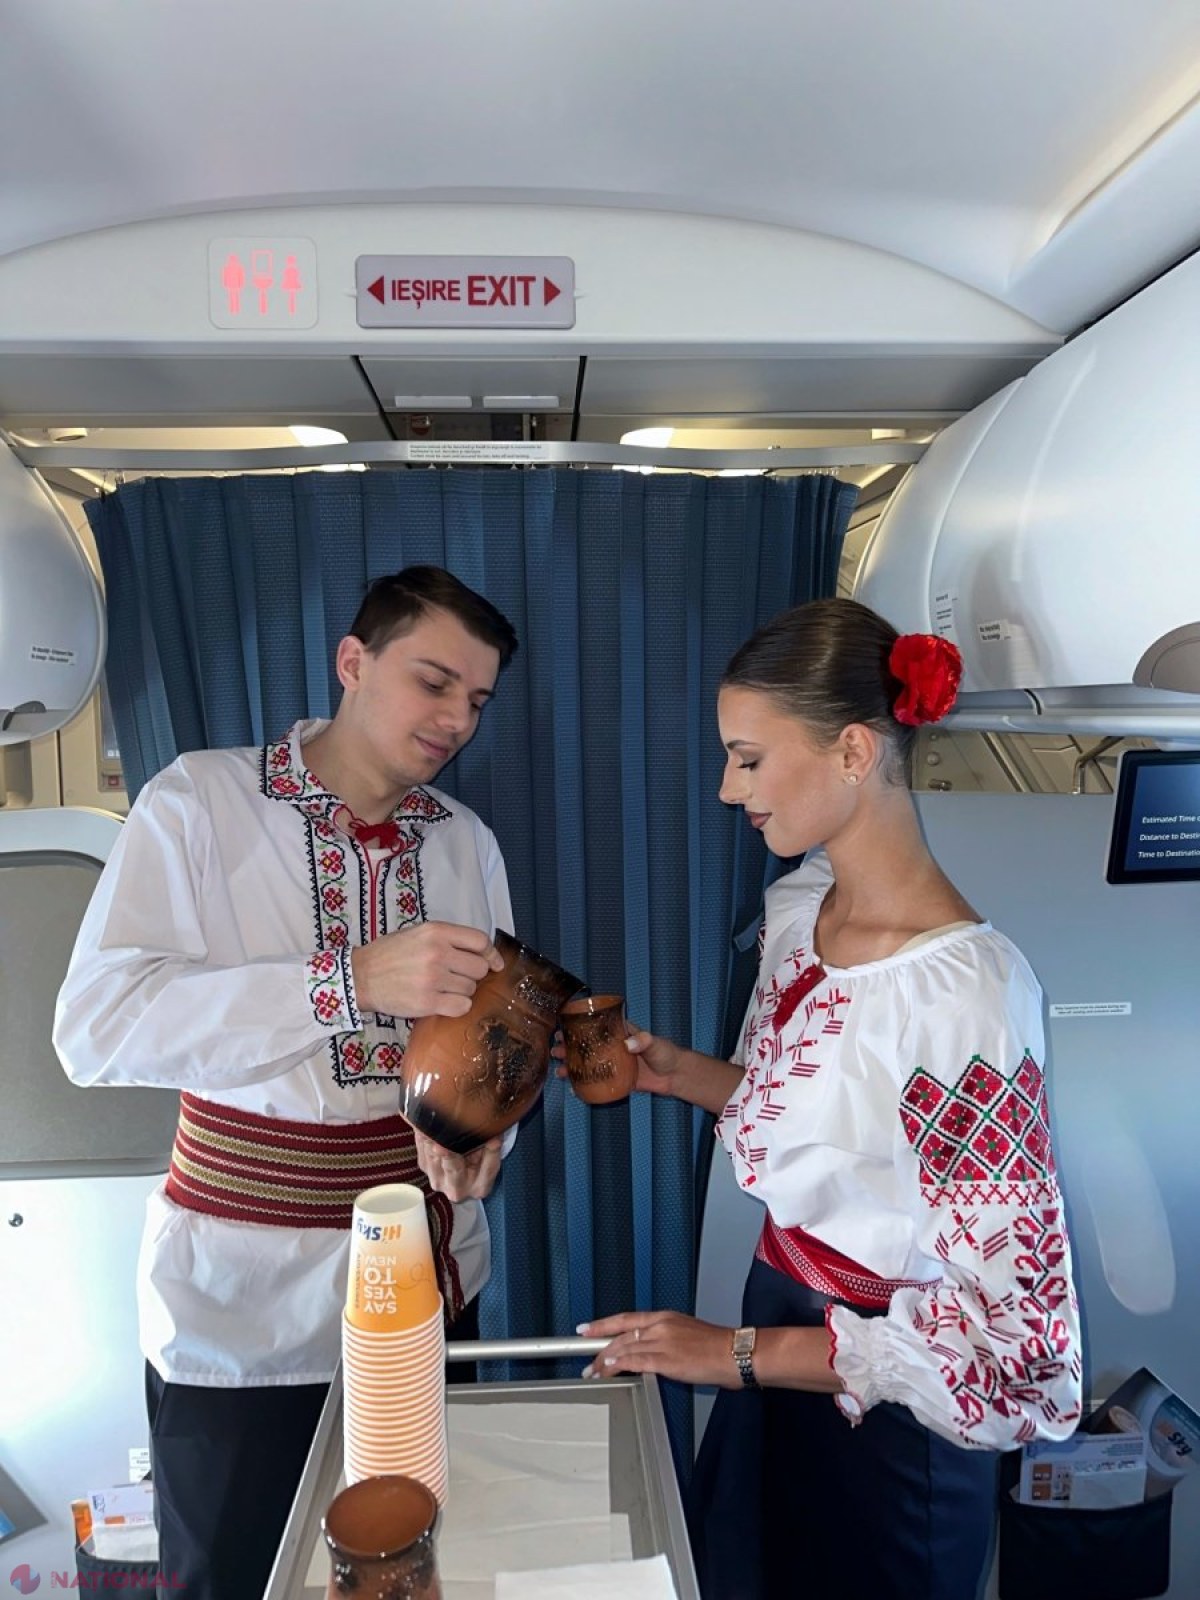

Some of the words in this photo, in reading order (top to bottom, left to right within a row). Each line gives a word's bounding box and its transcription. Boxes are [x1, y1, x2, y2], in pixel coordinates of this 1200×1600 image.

[391, 279, 461, 309] IEȘIRE
[467, 275, 537, 306] EXIT
[1142, 816, 1177, 824] Estimated
[1139, 833, 1170, 841] Distance
[356, 1217, 402, 1241] HiSky
[365, 1255, 397, 1265] NEW
[363, 1267, 397, 1285] TO
[363, 1285, 397, 1300] YES
[363, 1301, 397, 1314] SAY
